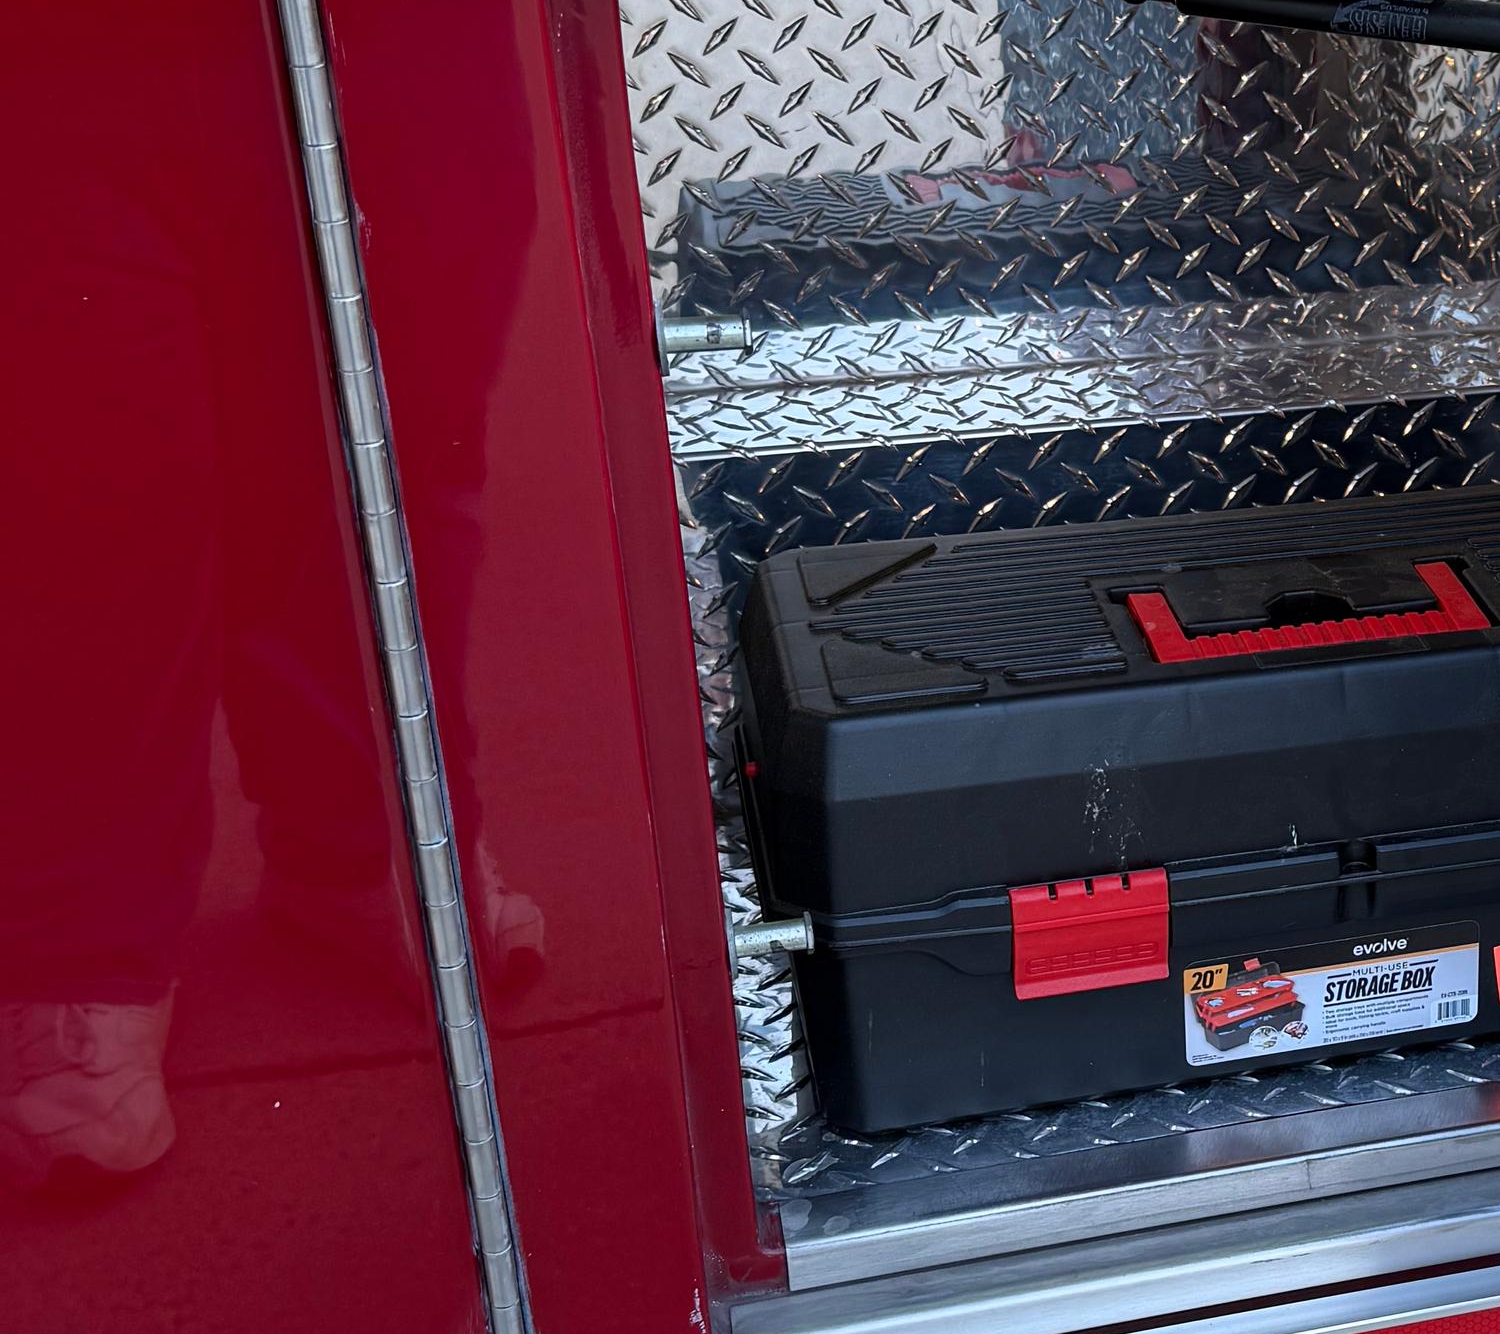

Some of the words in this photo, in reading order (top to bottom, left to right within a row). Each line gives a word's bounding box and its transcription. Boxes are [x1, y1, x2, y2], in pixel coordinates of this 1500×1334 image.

[1349, 9, 1427, 40] GENESIS
[1353, 938, 1408, 956] evolve
[1190, 968, 1223, 991] 20"
[1352, 962, 1409, 976] MULTI-USE
[1324, 972, 1401, 1003] STORAGE
[1401, 966, 1436, 991] BOX
